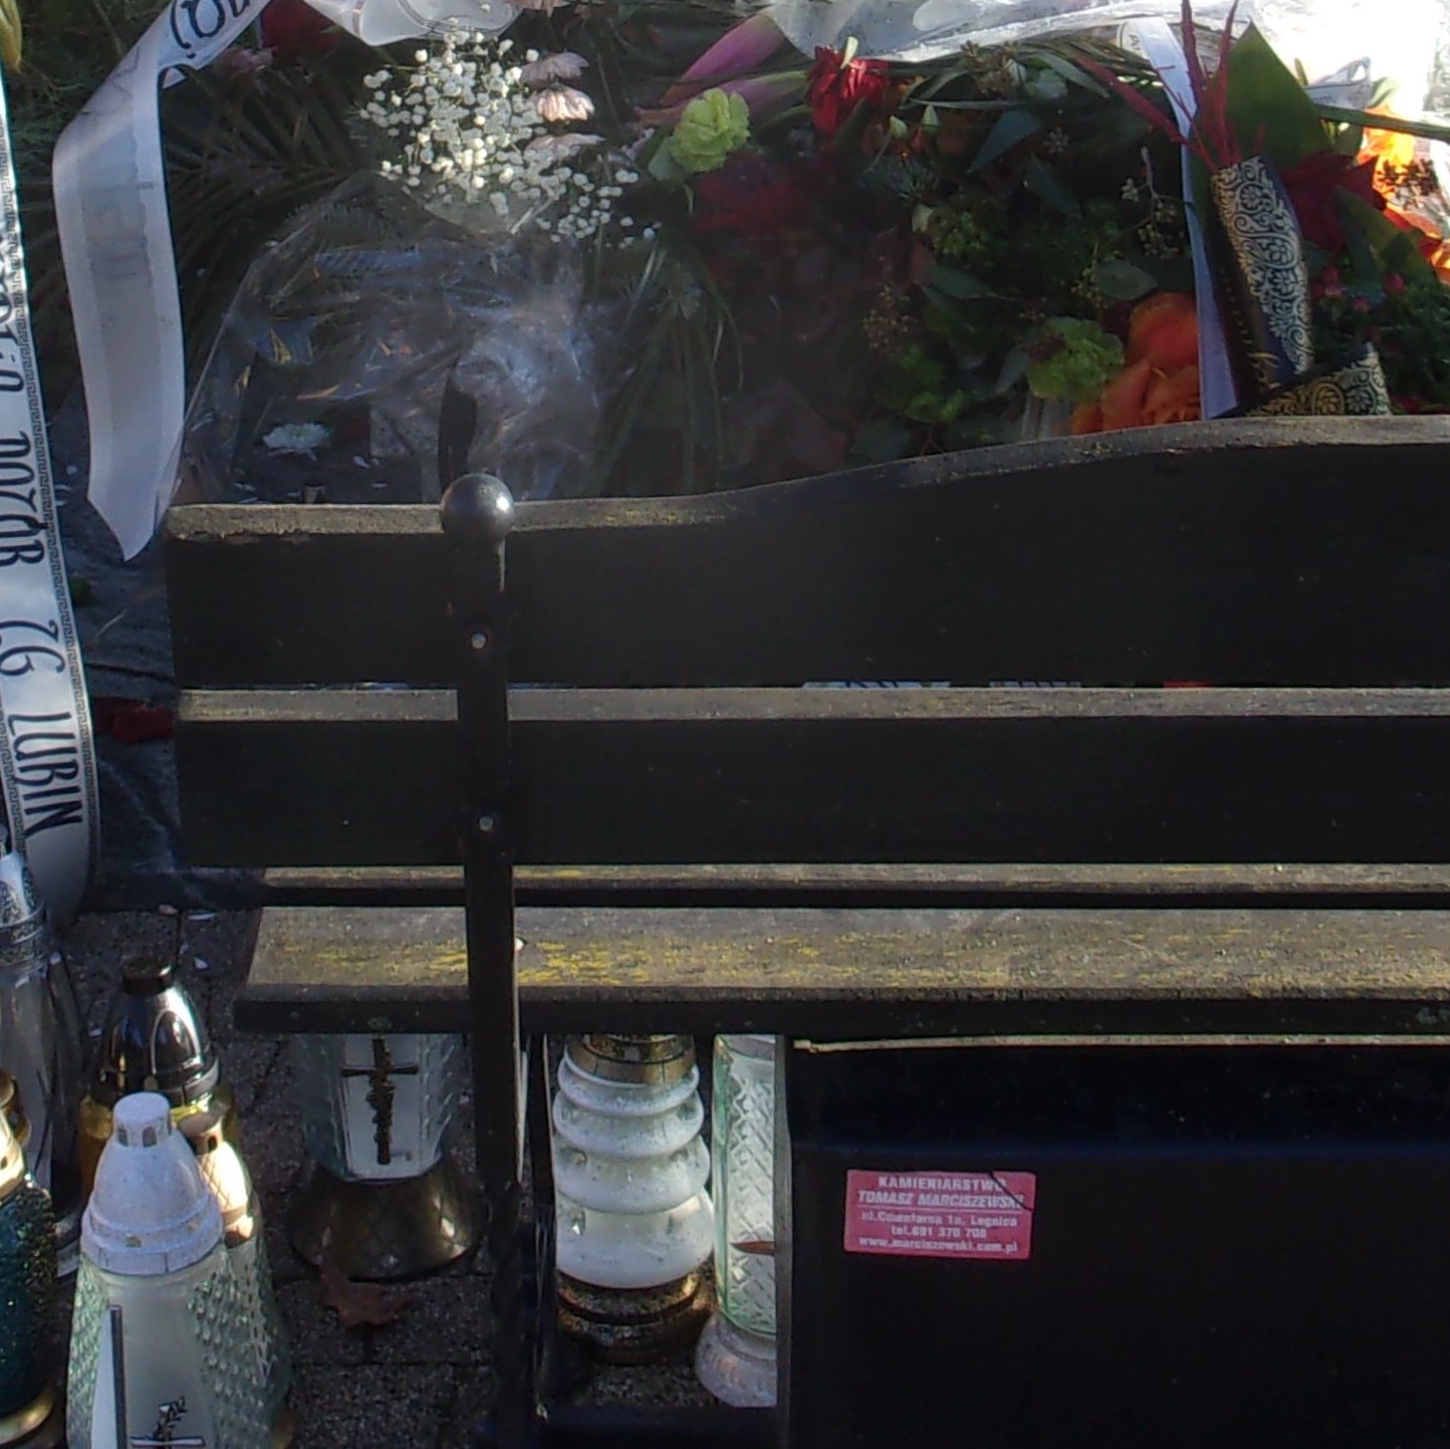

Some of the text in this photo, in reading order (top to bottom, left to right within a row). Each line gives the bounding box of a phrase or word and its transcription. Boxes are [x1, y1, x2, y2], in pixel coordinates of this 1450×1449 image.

[8, 710, 85, 837] LUBIN
[878, 1176, 1007, 1191] KAMIENIARSTWO
[858, 1190, 1025, 1210] TOMASZ MARCISZEWSKI
[970, 1215, 1019, 1229] Legnica
